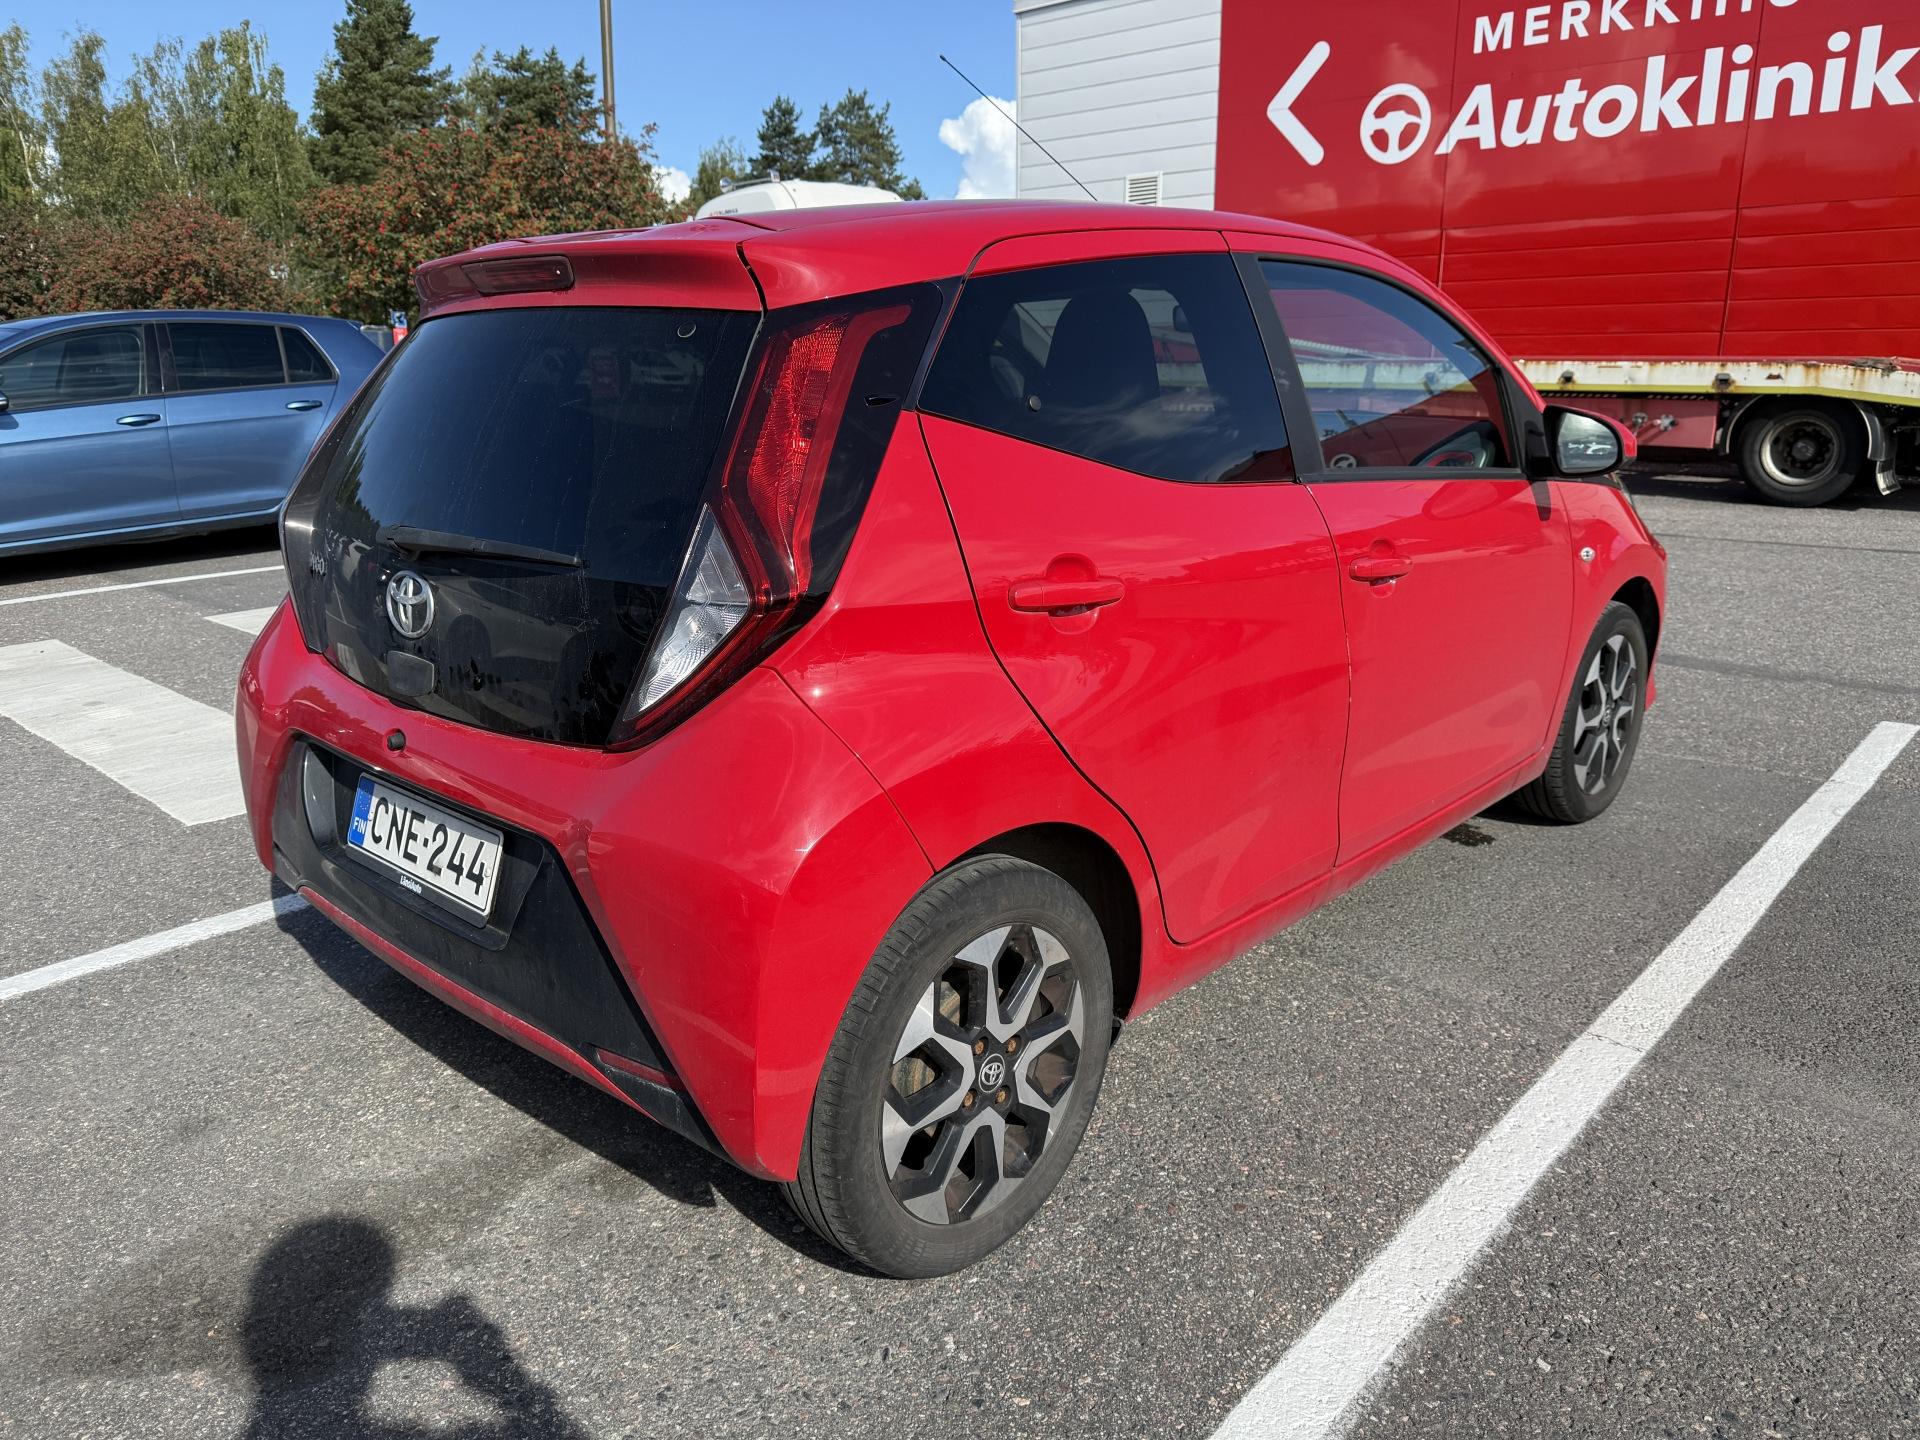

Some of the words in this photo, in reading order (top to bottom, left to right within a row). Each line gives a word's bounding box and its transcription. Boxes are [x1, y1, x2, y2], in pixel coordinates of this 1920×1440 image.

[1434, 25, 1920, 155] Autoklinik
[353, 816, 367, 835] FIN
[371, 796, 486, 896] CNE-244
